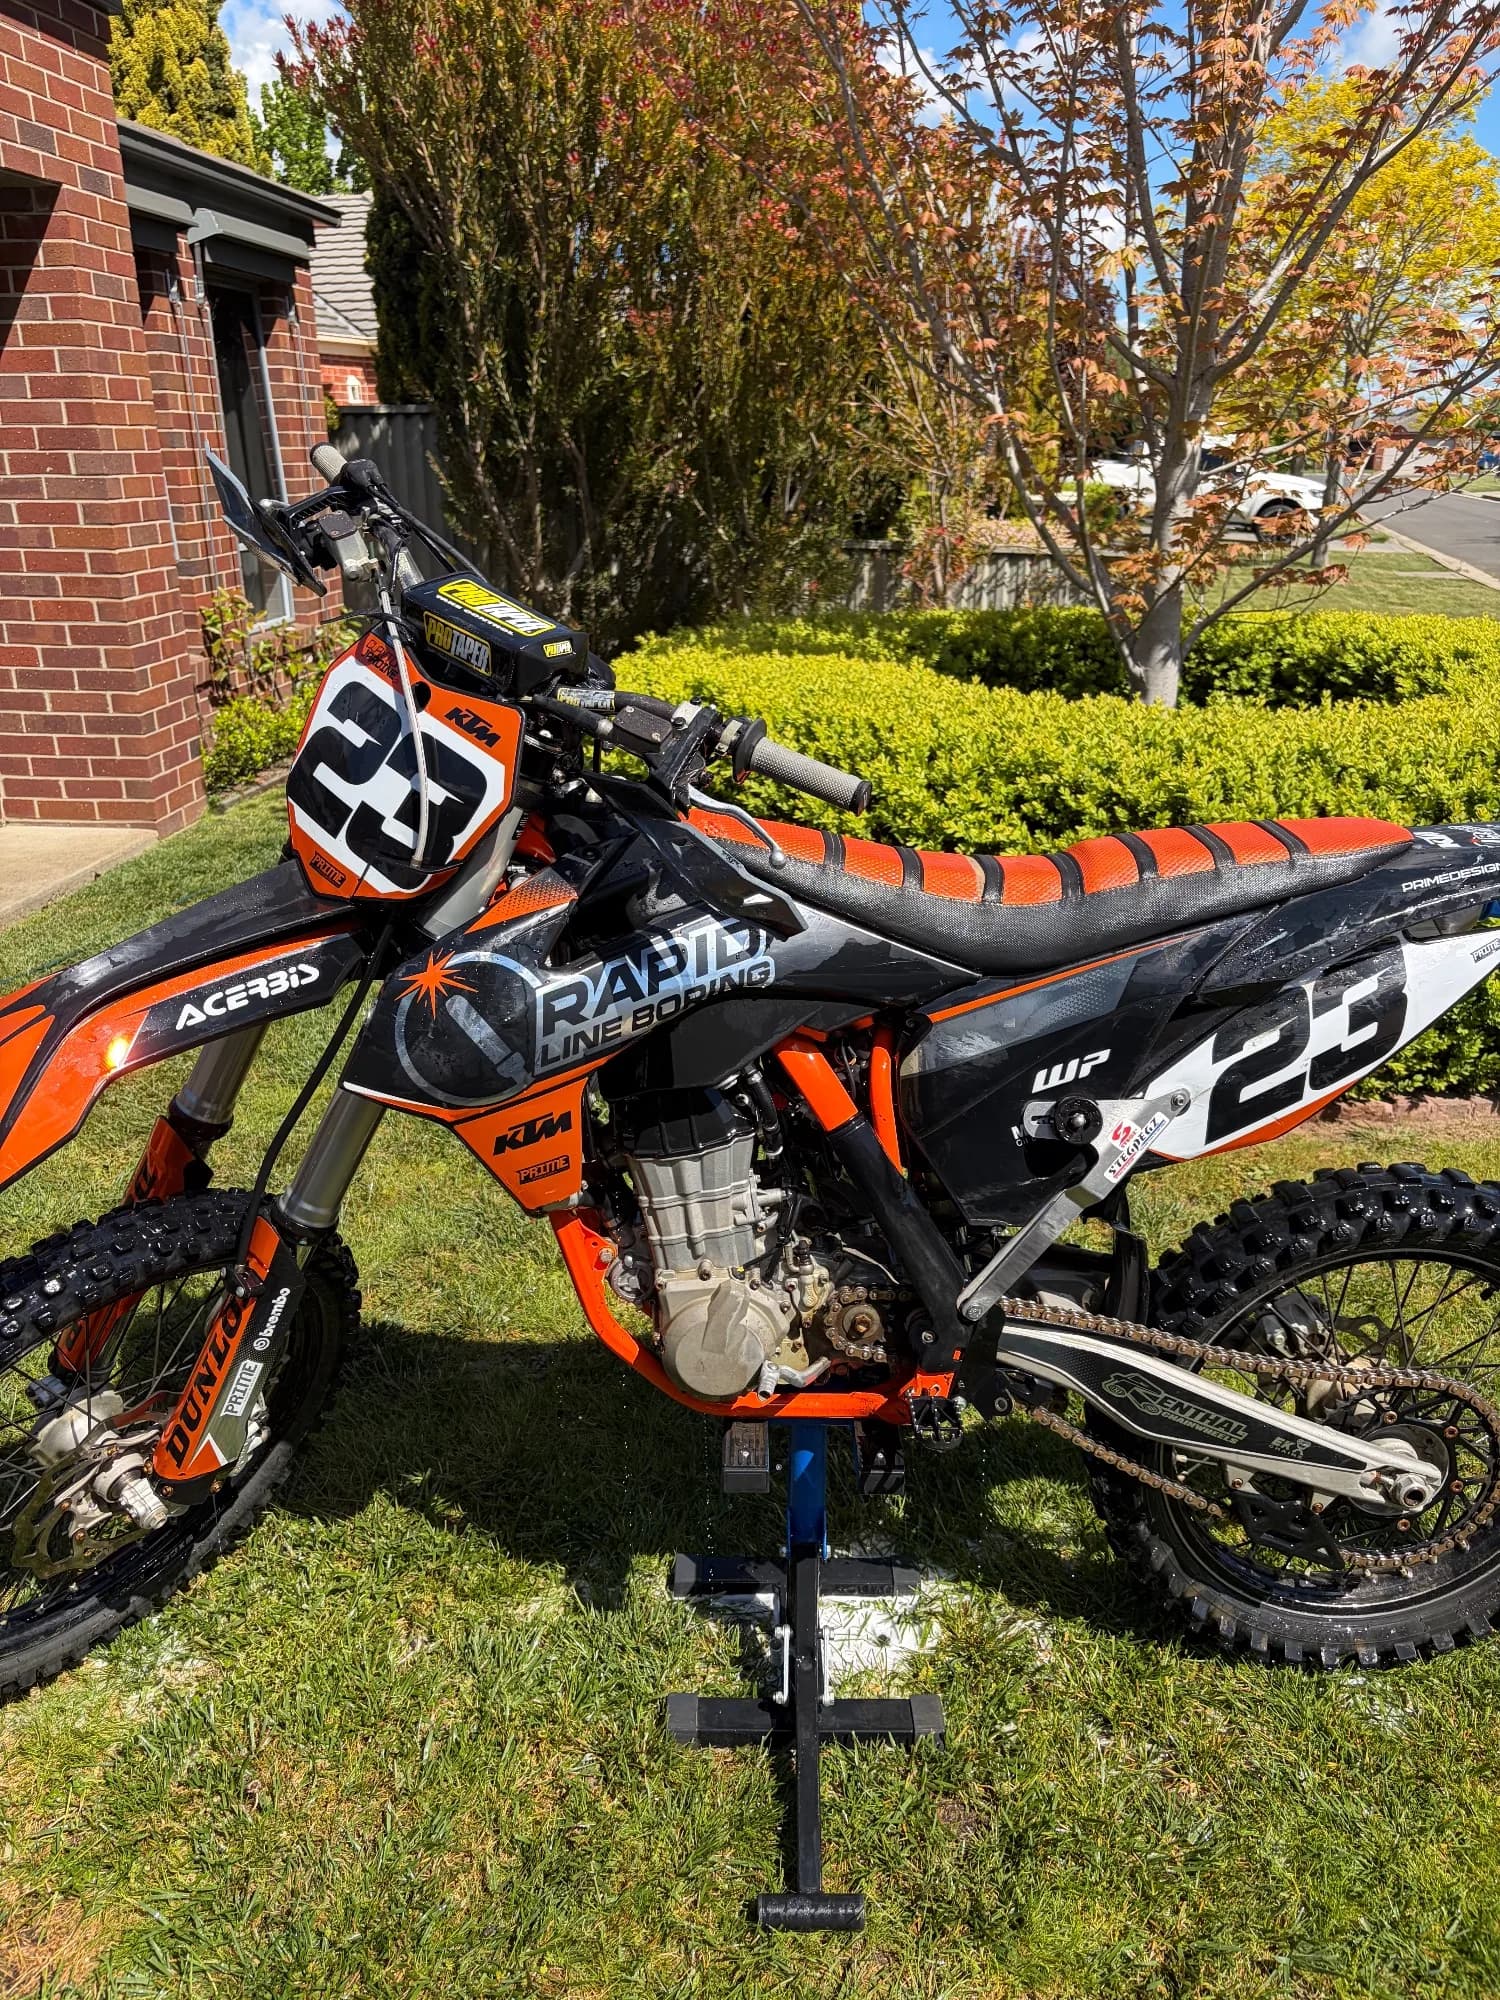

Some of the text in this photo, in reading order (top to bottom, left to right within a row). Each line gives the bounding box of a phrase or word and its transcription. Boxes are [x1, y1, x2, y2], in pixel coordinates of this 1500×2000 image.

[426, 616, 490, 672] PROTAPER
[444, 707, 501, 748] KTM
[286, 680, 488, 890] 23
[311, 853, 346, 886] PRIME
[542, 920, 763, 1037] RAPID
[541, 960, 772, 1067] LINE BORING
[1032, 1048, 1111, 1093] WP
[1205, 945, 1408, 1146] 23
[493, 1110, 573, 1156] KTM
[519, 1156, 569, 1182] PRIME
[259, 1287, 291, 1337] brembo
[166, 1296, 245, 1469] DUNLO
[225, 1362, 258, 1415] PRIME
[1161, 1411, 1239, 1445] CHAINWHEELS
[1271, 1436, 1297, 1451] EK
